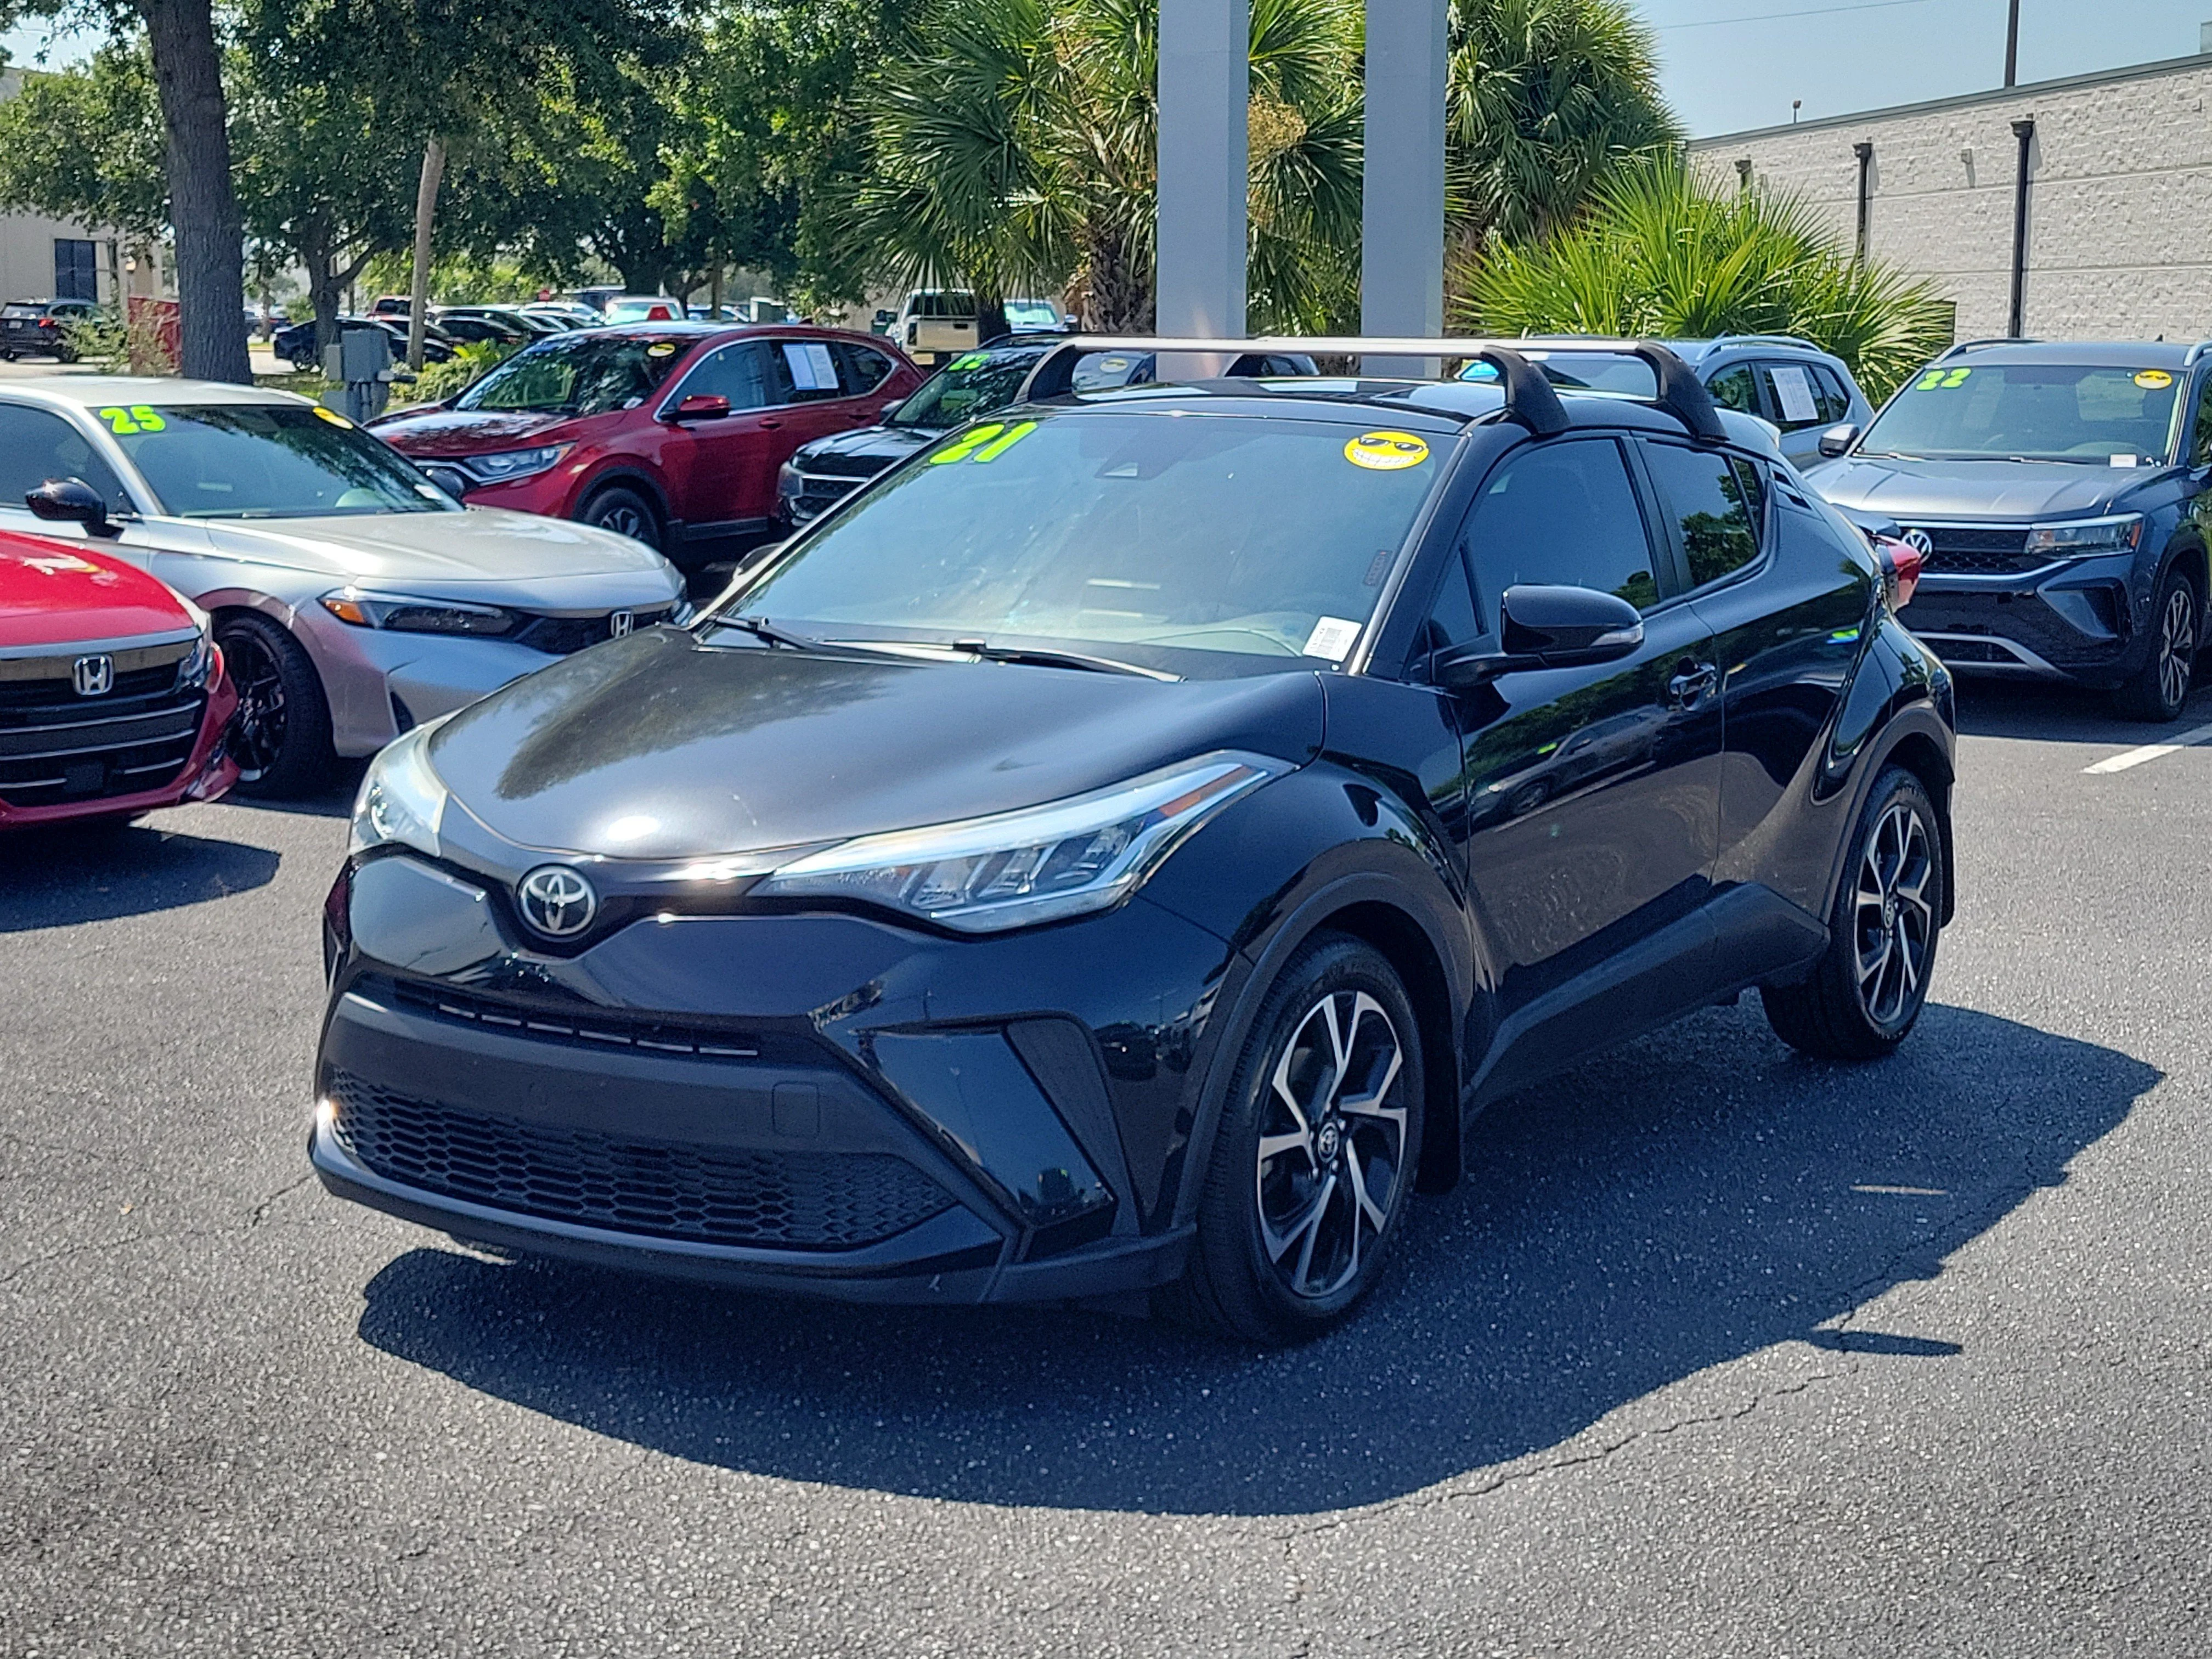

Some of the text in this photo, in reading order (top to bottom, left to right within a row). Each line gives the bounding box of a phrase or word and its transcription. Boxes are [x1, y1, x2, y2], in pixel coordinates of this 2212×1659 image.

[1916, 368, 1971, 390] 22
[99, 405, 166, 434] 25
[929, 421, 1038, 464] 21
